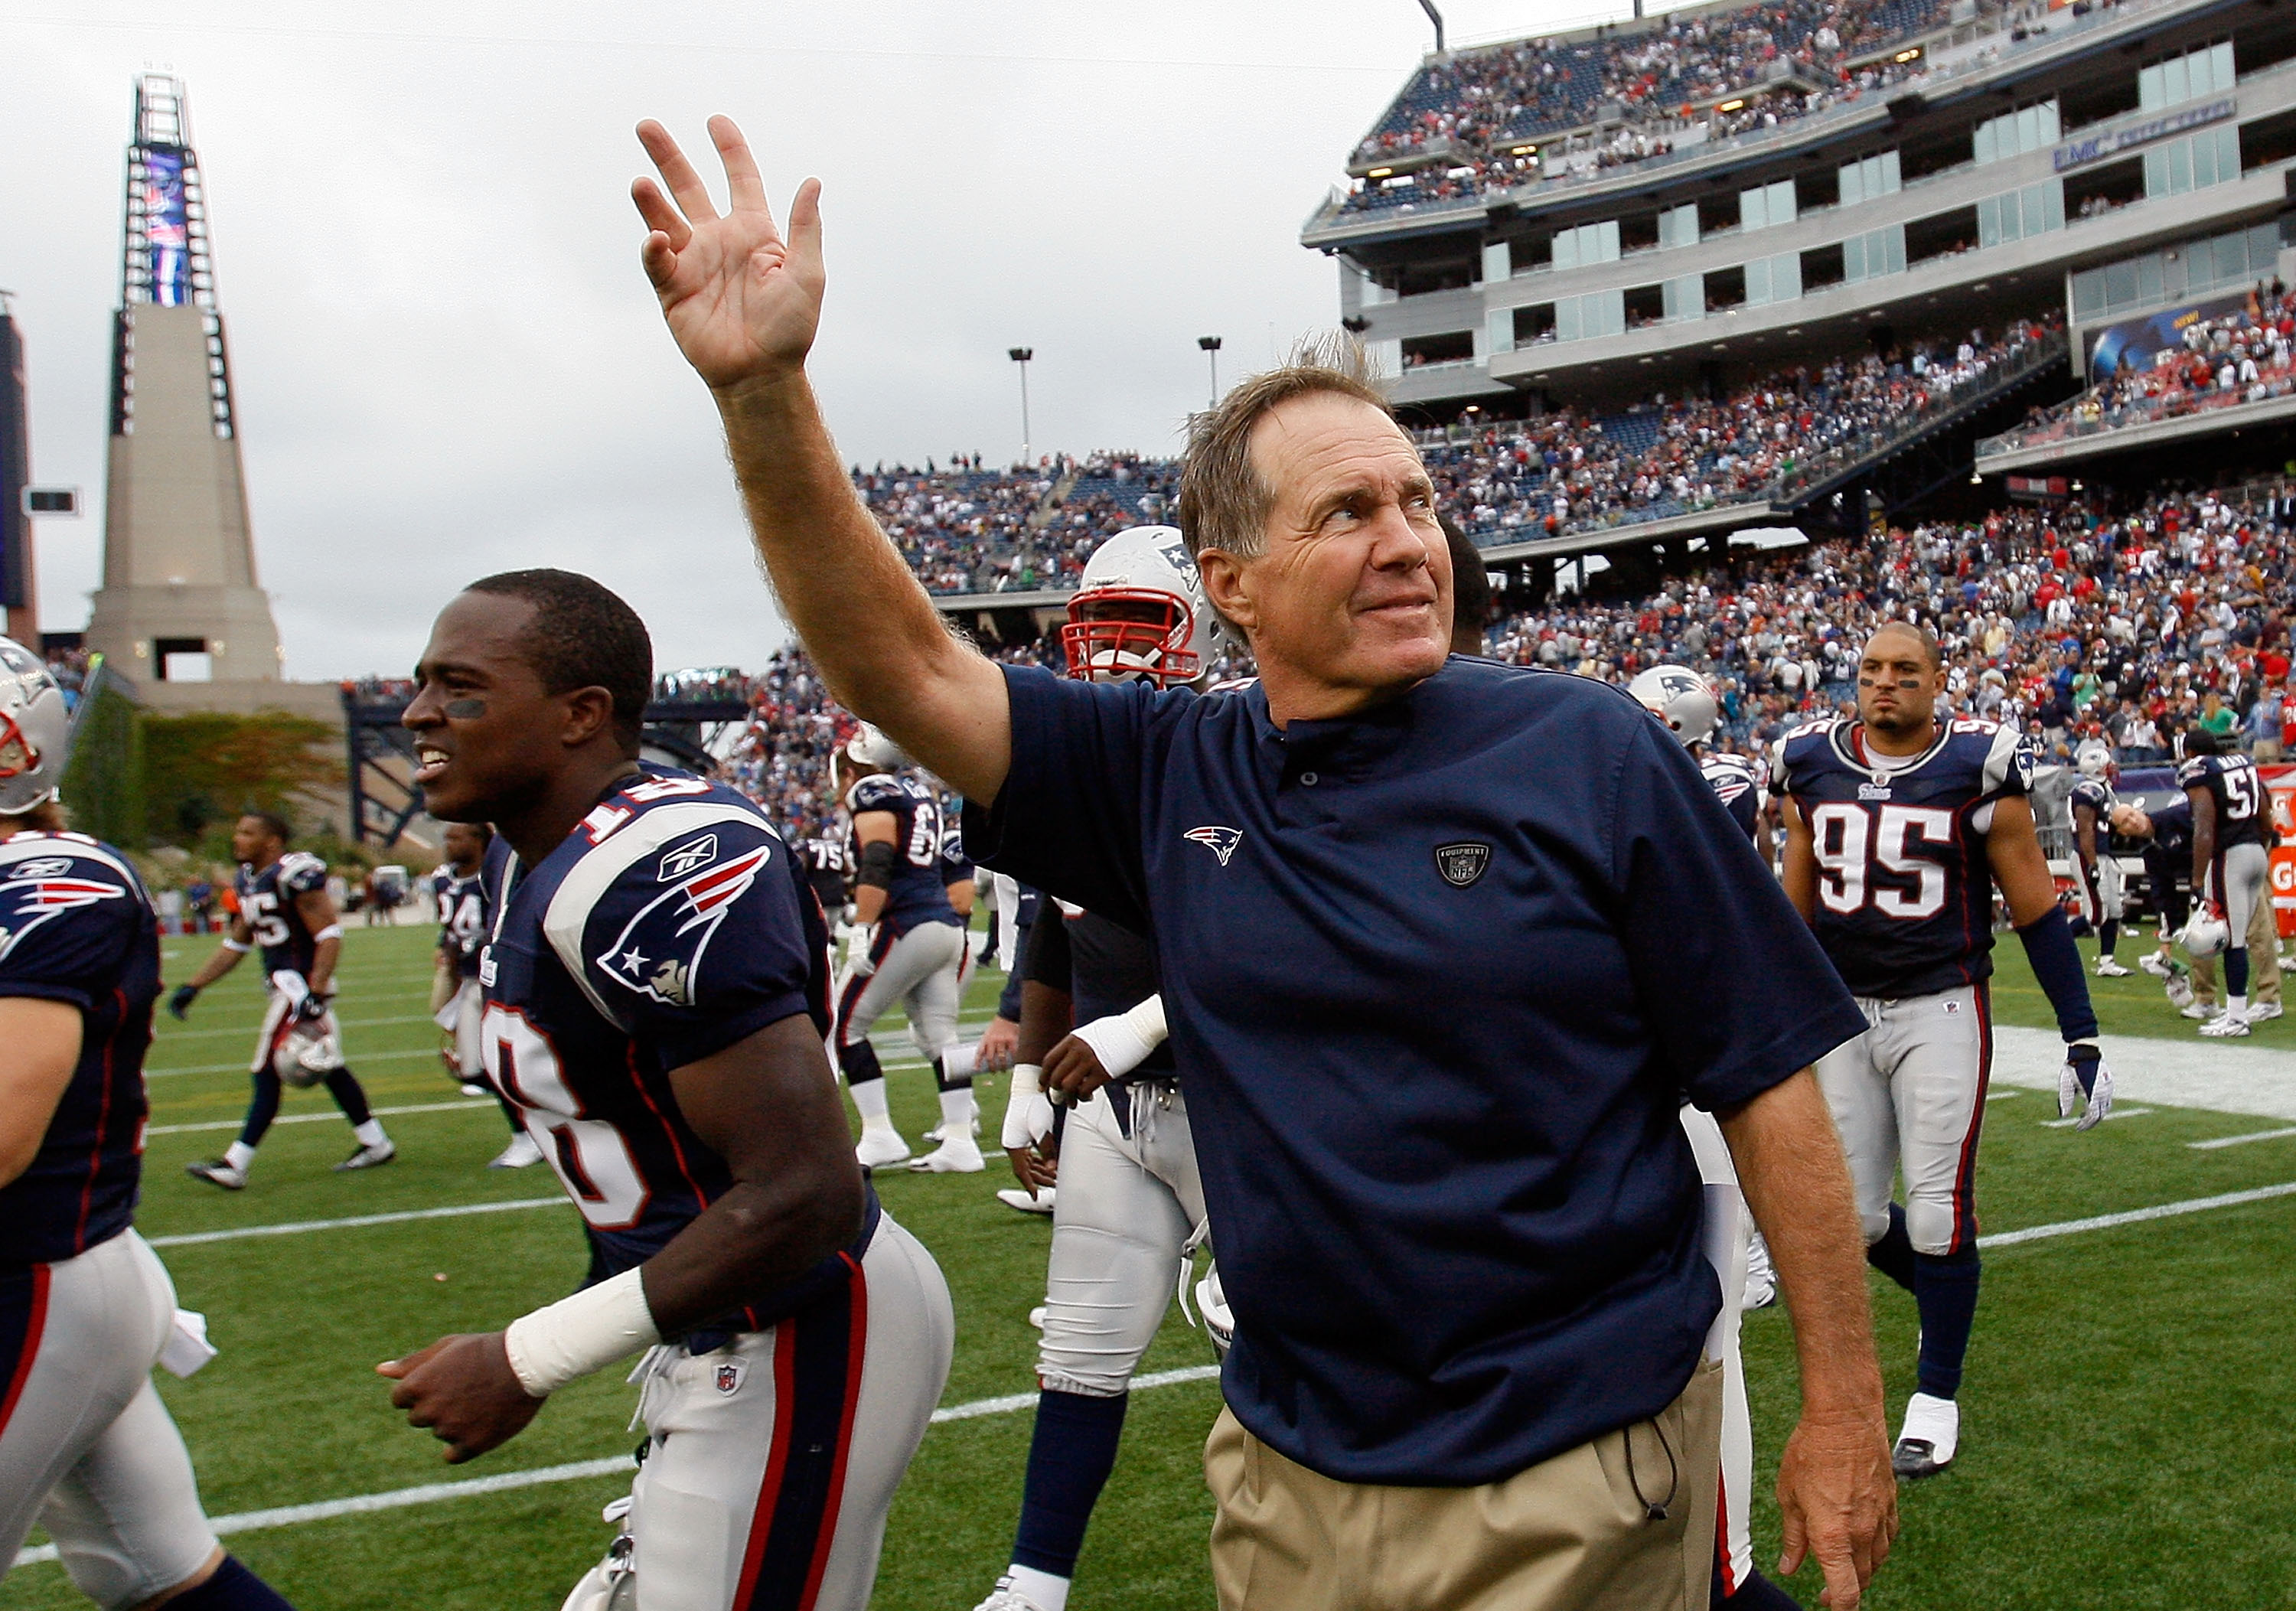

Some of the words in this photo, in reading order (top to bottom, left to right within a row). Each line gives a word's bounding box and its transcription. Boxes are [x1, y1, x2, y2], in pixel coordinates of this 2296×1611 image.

[2223, 765, 2259, 820] 51
[807, 838, 843, 871] 75
[1440, 848, 1485, 857] EQUIPMENT
[1812, 801, 1955, 920] 95
[2272, 861, 2296, 892] G
